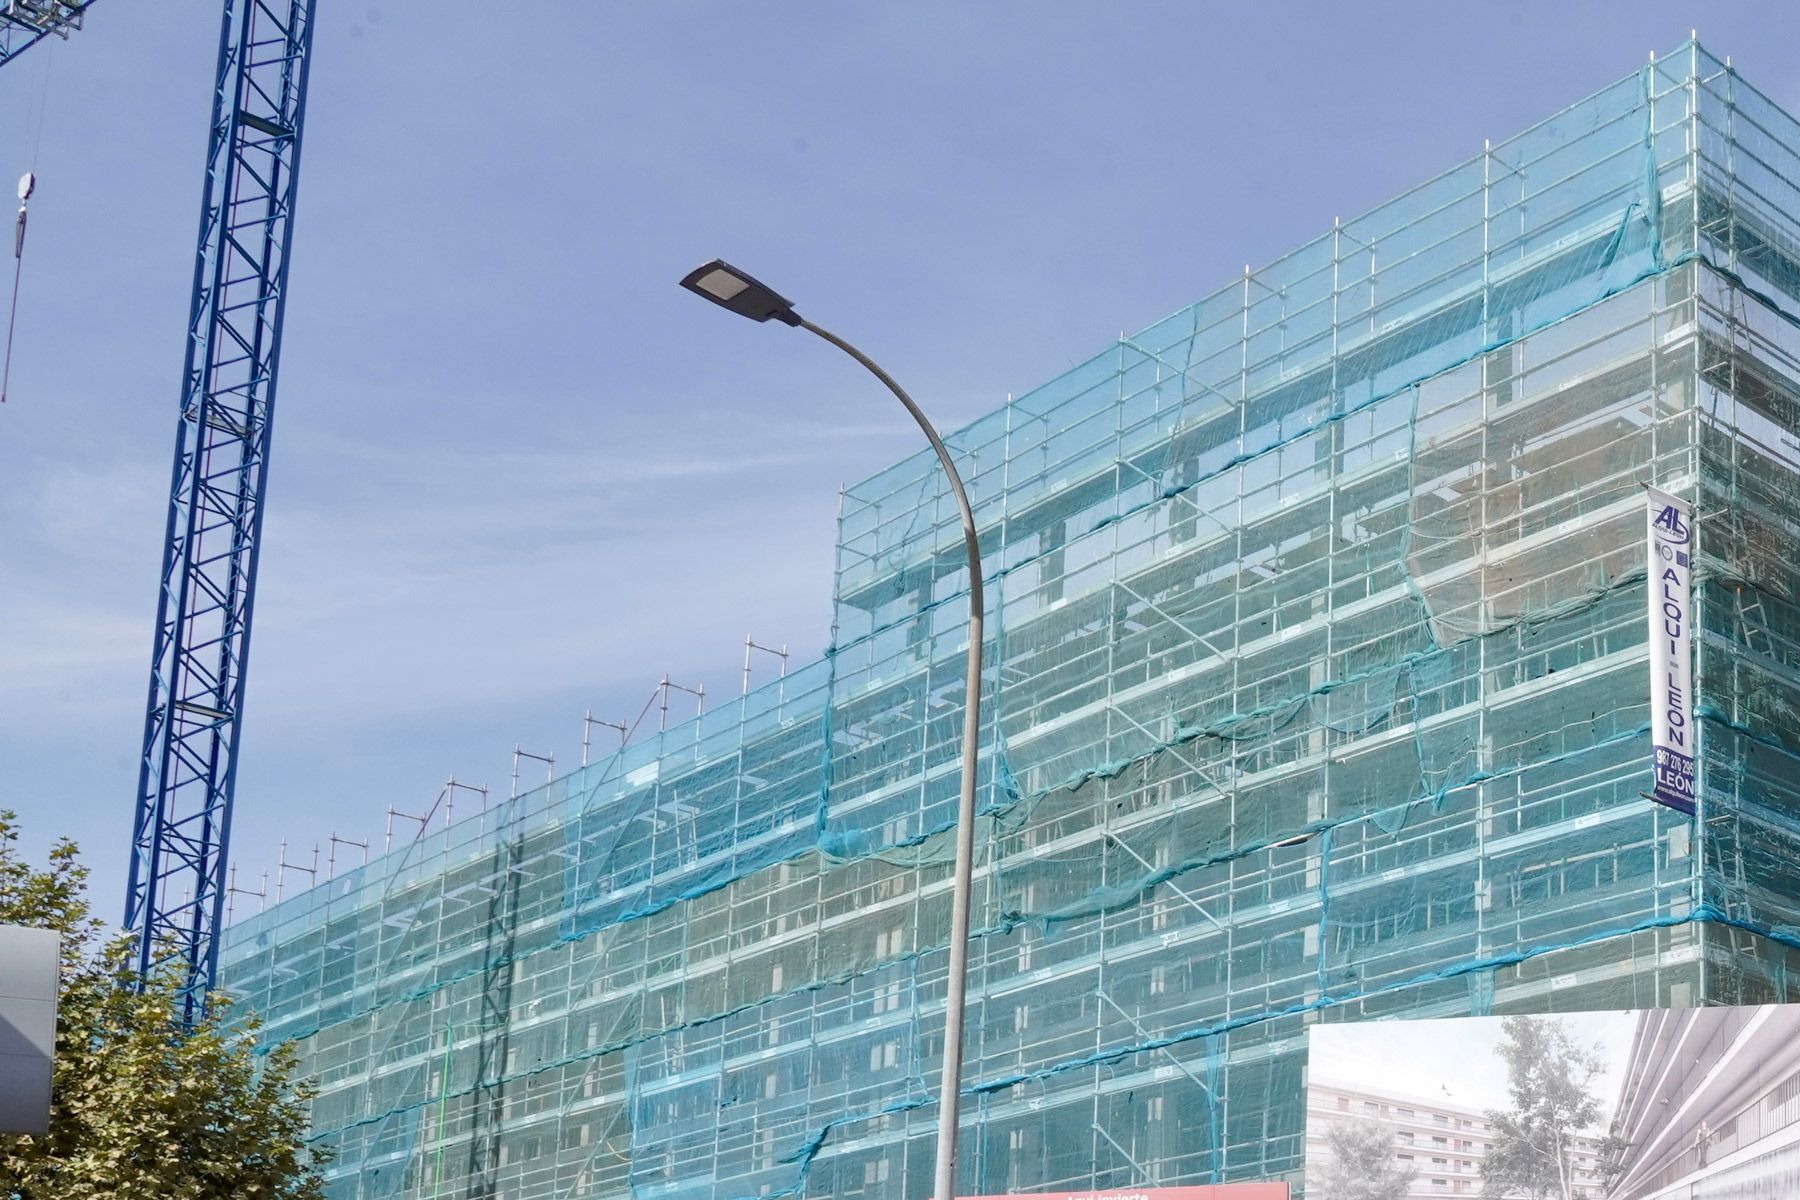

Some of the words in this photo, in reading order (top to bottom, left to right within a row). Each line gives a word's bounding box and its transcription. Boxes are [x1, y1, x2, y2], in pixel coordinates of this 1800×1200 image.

[1655, 505, 1685, 535] AL
[1656, 749, 1669, 766] 987
[1657, 768, 1694, 795] LEÓN
